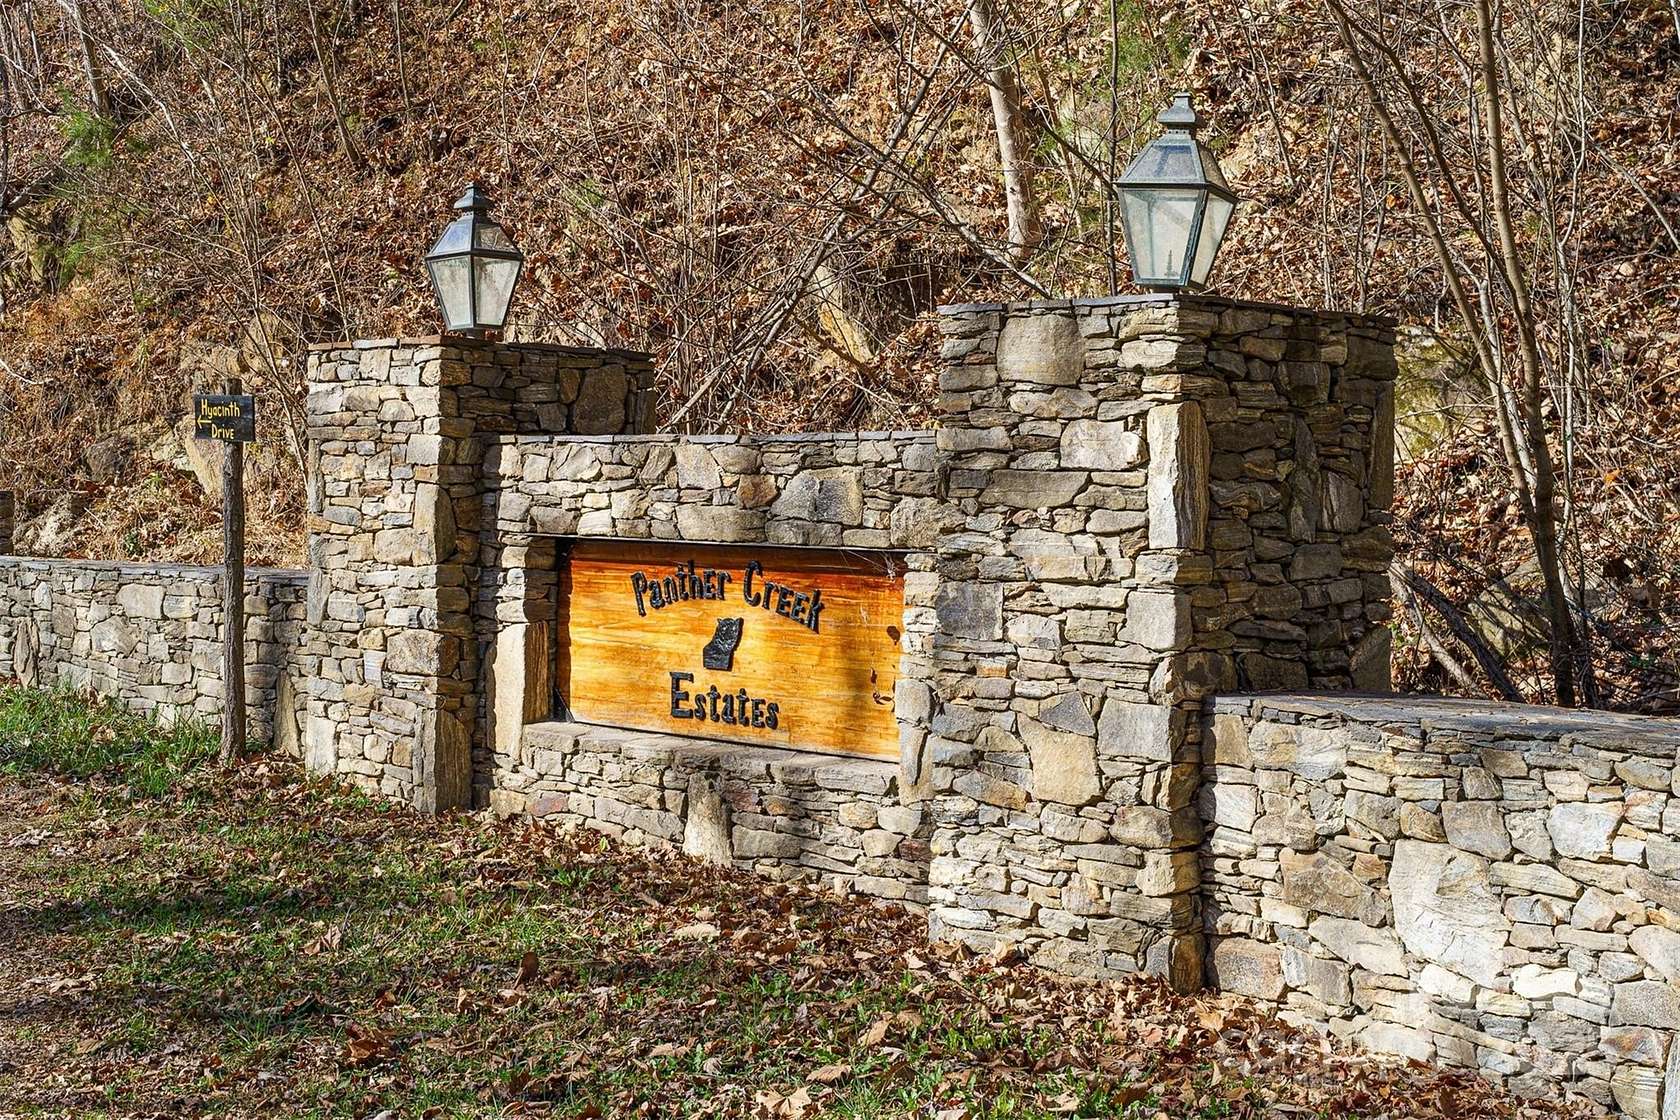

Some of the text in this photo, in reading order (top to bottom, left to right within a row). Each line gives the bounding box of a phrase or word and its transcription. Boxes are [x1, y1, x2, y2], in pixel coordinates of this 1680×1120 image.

[201, 398, 240, 419] Hyacinth
[211, 423, 235, 440] Drive
[630, 559, 825, 634] Panther Creek
[669, 671, 780, 730] Estates
